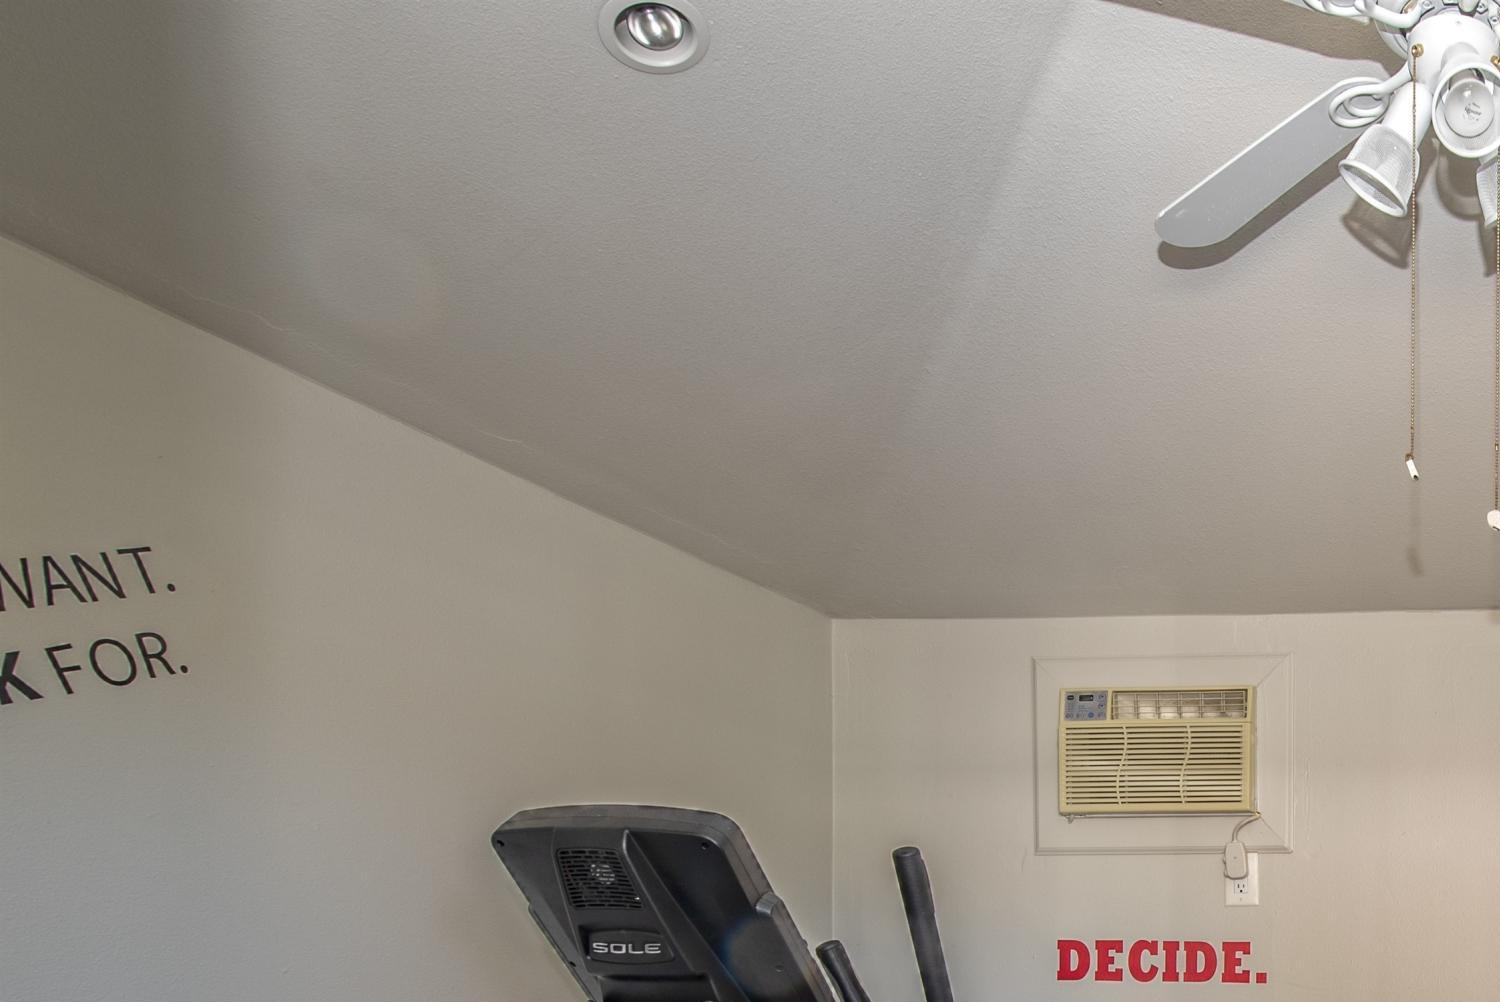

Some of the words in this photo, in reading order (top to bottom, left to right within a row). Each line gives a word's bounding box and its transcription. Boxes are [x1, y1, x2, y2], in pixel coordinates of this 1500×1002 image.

[45, 632, 188, 695] FOR.
[592, 942, 662, 954] SOLE
[1057, 939, 1267, 984] DECIDE.
